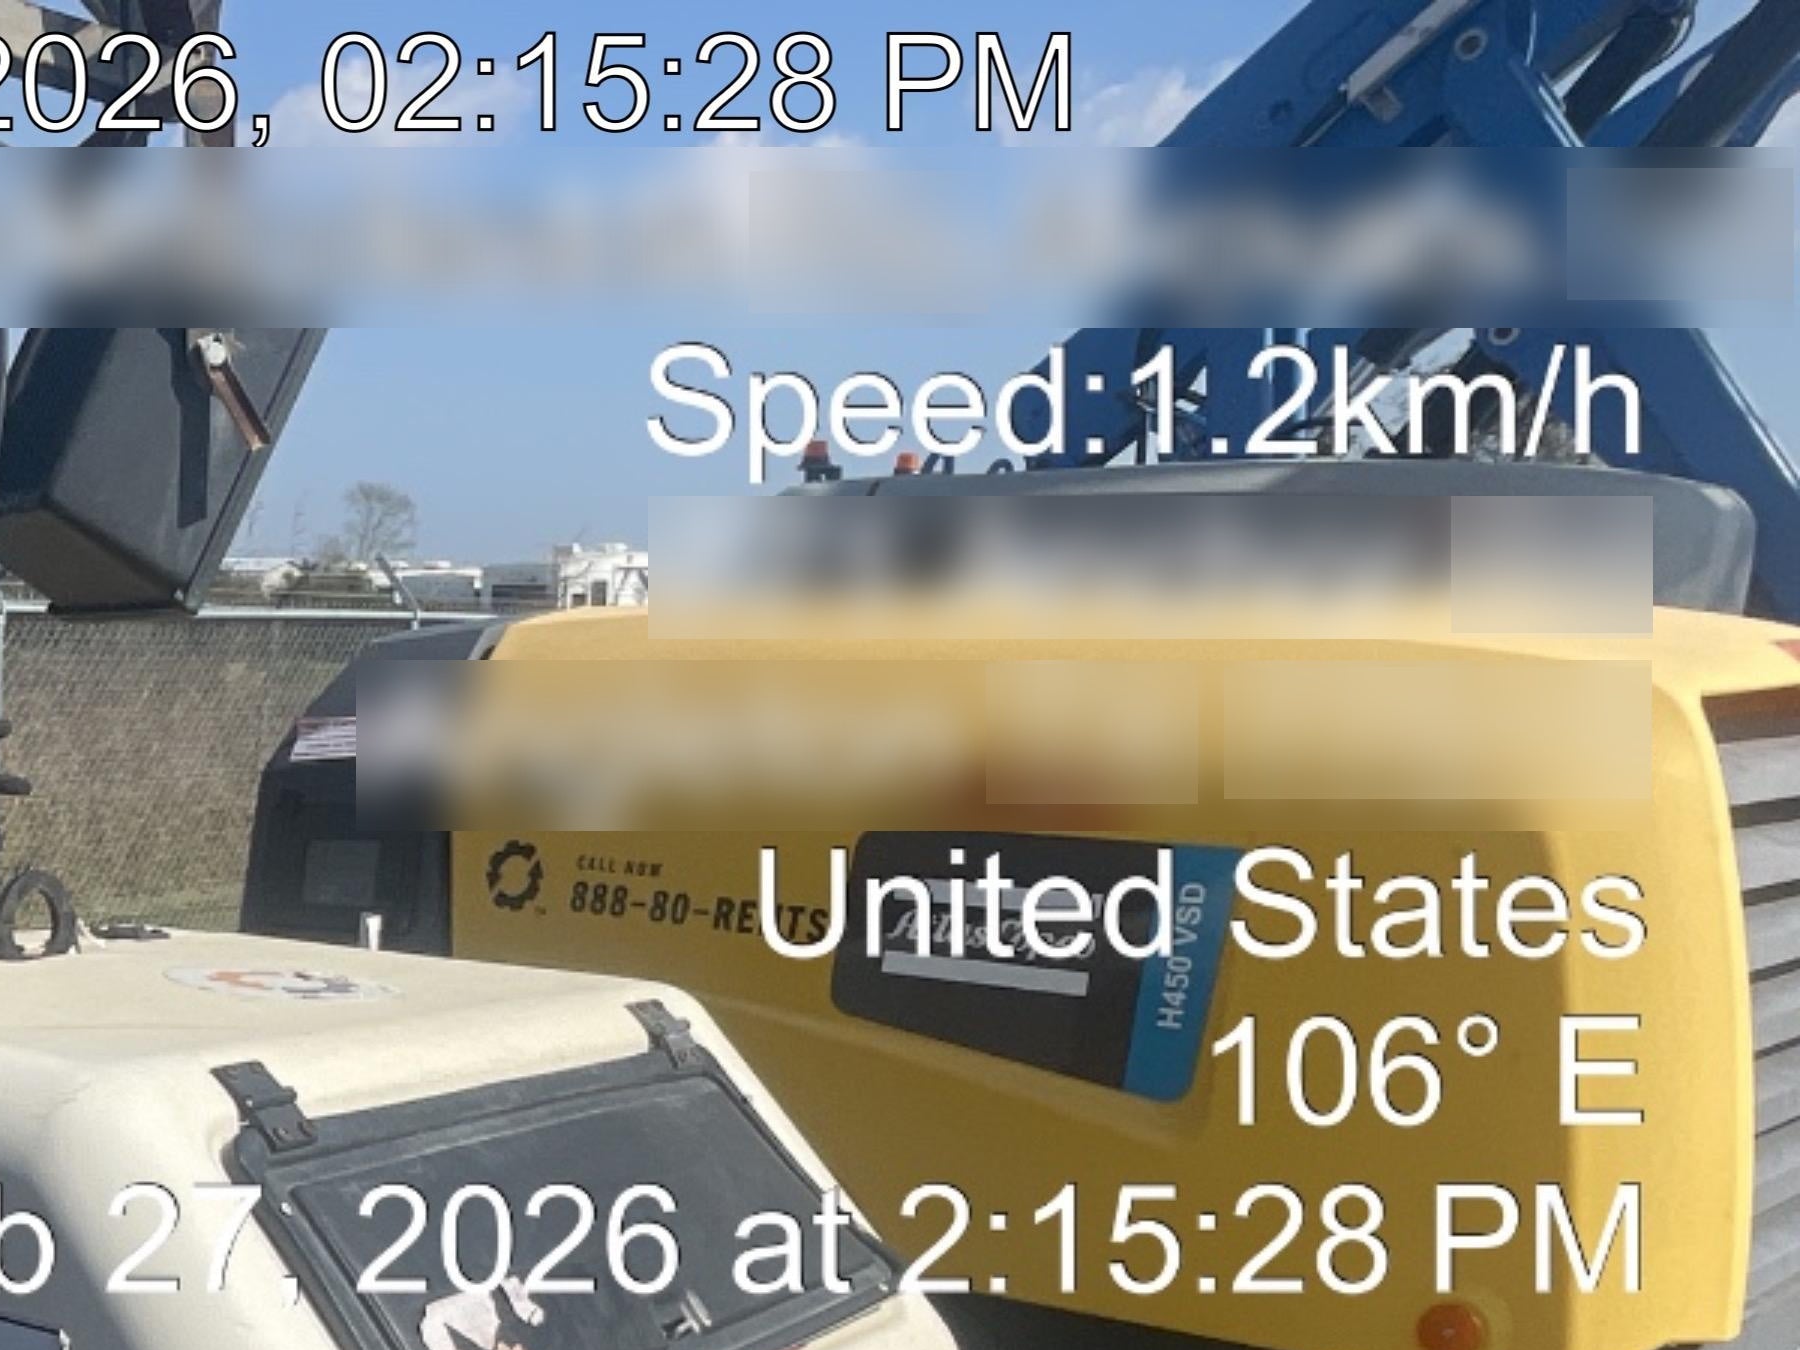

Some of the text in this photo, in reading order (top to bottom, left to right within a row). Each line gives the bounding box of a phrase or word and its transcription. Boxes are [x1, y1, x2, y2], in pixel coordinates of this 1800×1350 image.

[575, 854, 664, 878] CALL NOW
[1155, 882, 1207, 1030] H450 VSD
